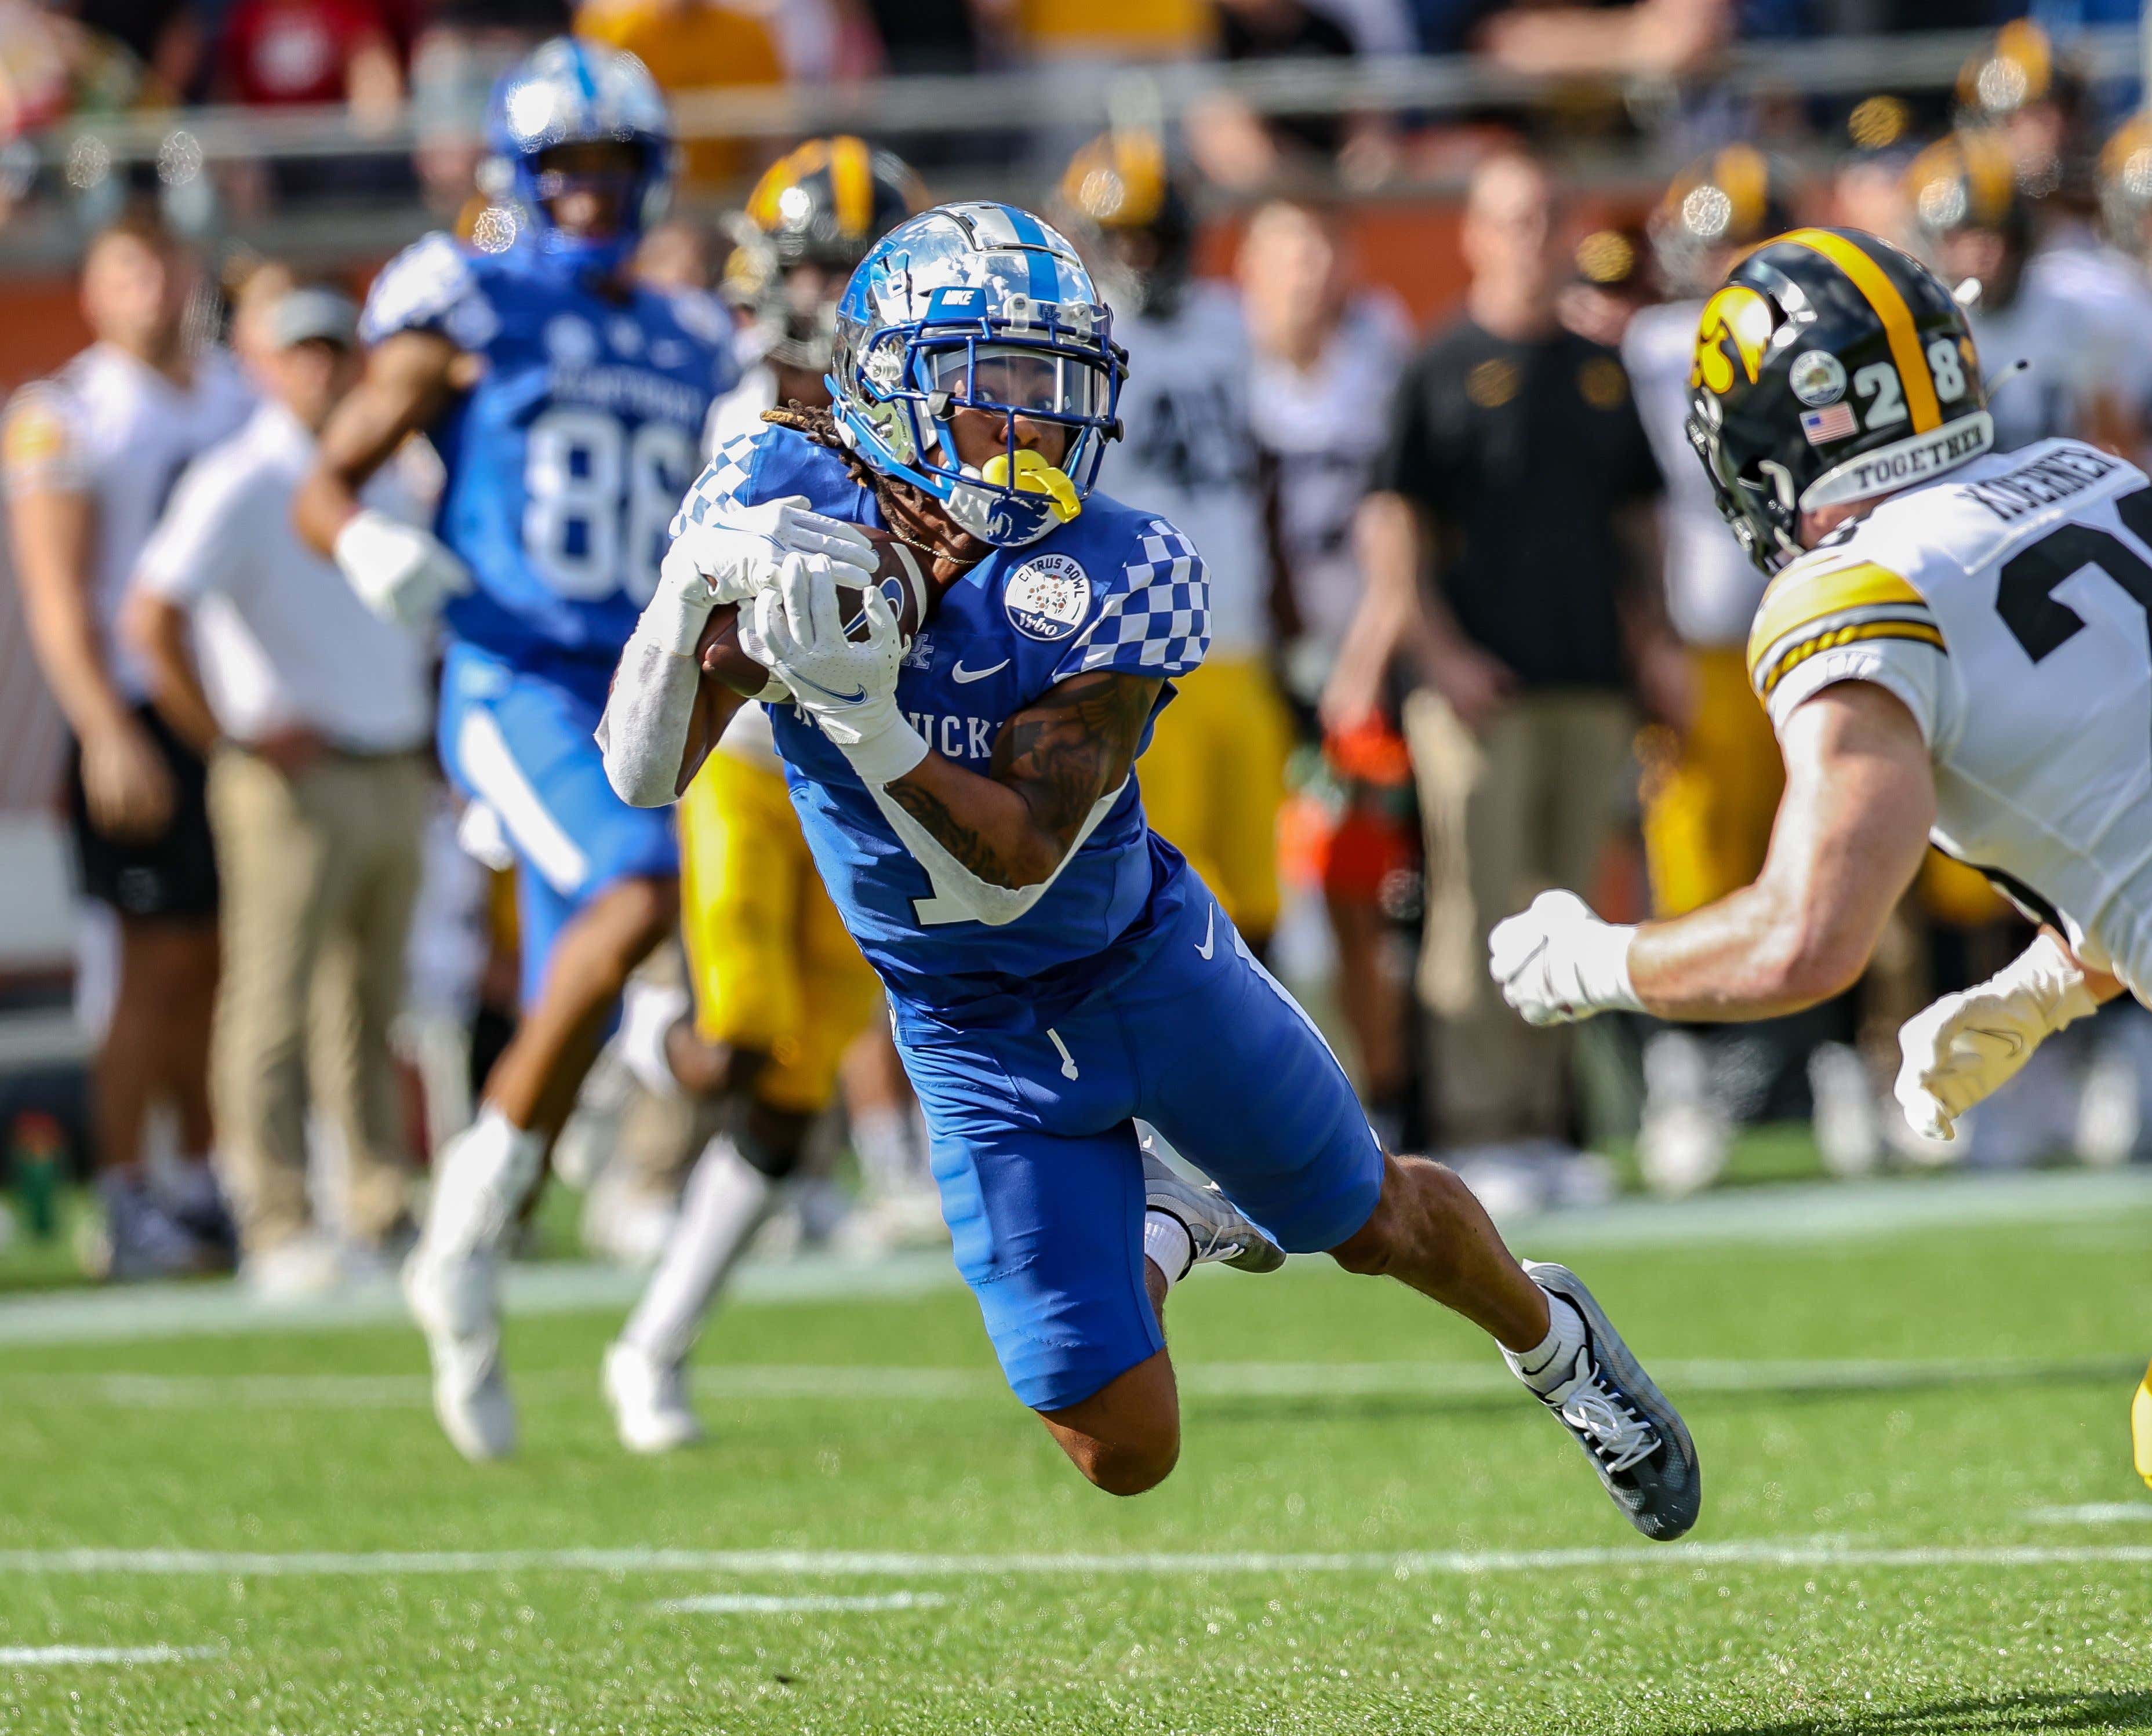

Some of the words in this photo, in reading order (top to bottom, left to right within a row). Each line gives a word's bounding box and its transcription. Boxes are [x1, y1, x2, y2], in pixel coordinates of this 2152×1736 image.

[1854, 339, 1966, 430] 28
[1019, 558, 1063, 582] CITRUS
[1063, 563, 1085, 598] BOWL
